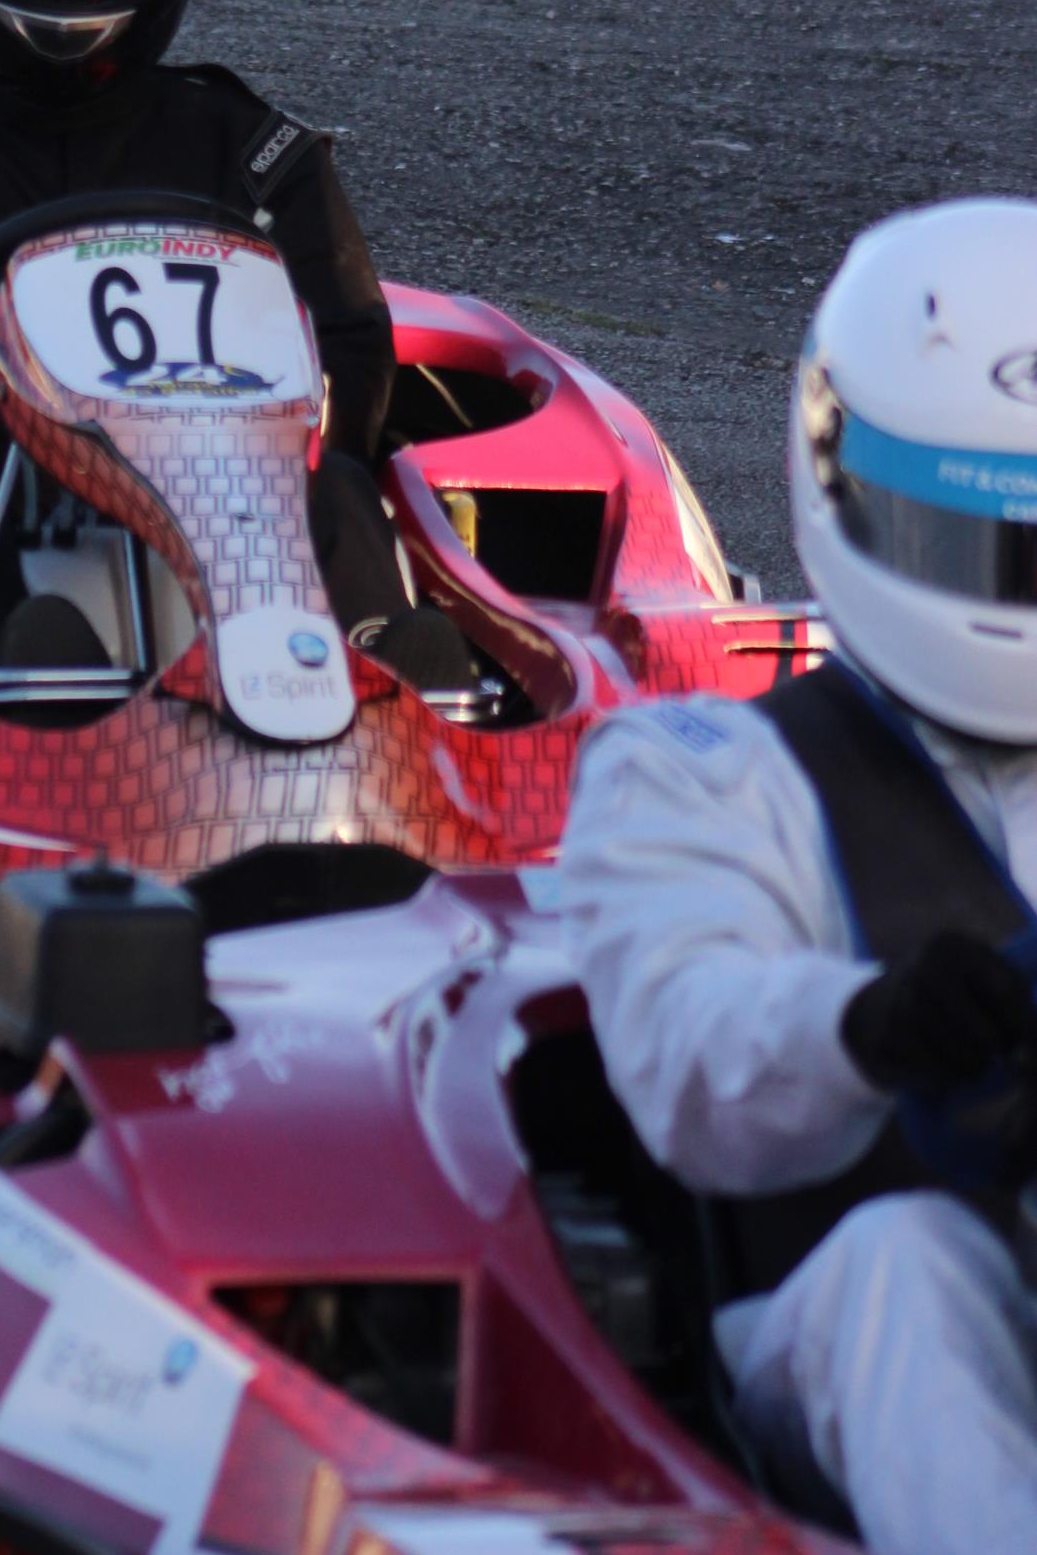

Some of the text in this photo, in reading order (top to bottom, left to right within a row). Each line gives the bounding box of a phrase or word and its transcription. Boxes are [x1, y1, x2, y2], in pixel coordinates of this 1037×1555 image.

[250, 124, 295, 173] sparco
[75, 237, 236, 261] EUROINDY
[89, 261, 220, 374] 67
